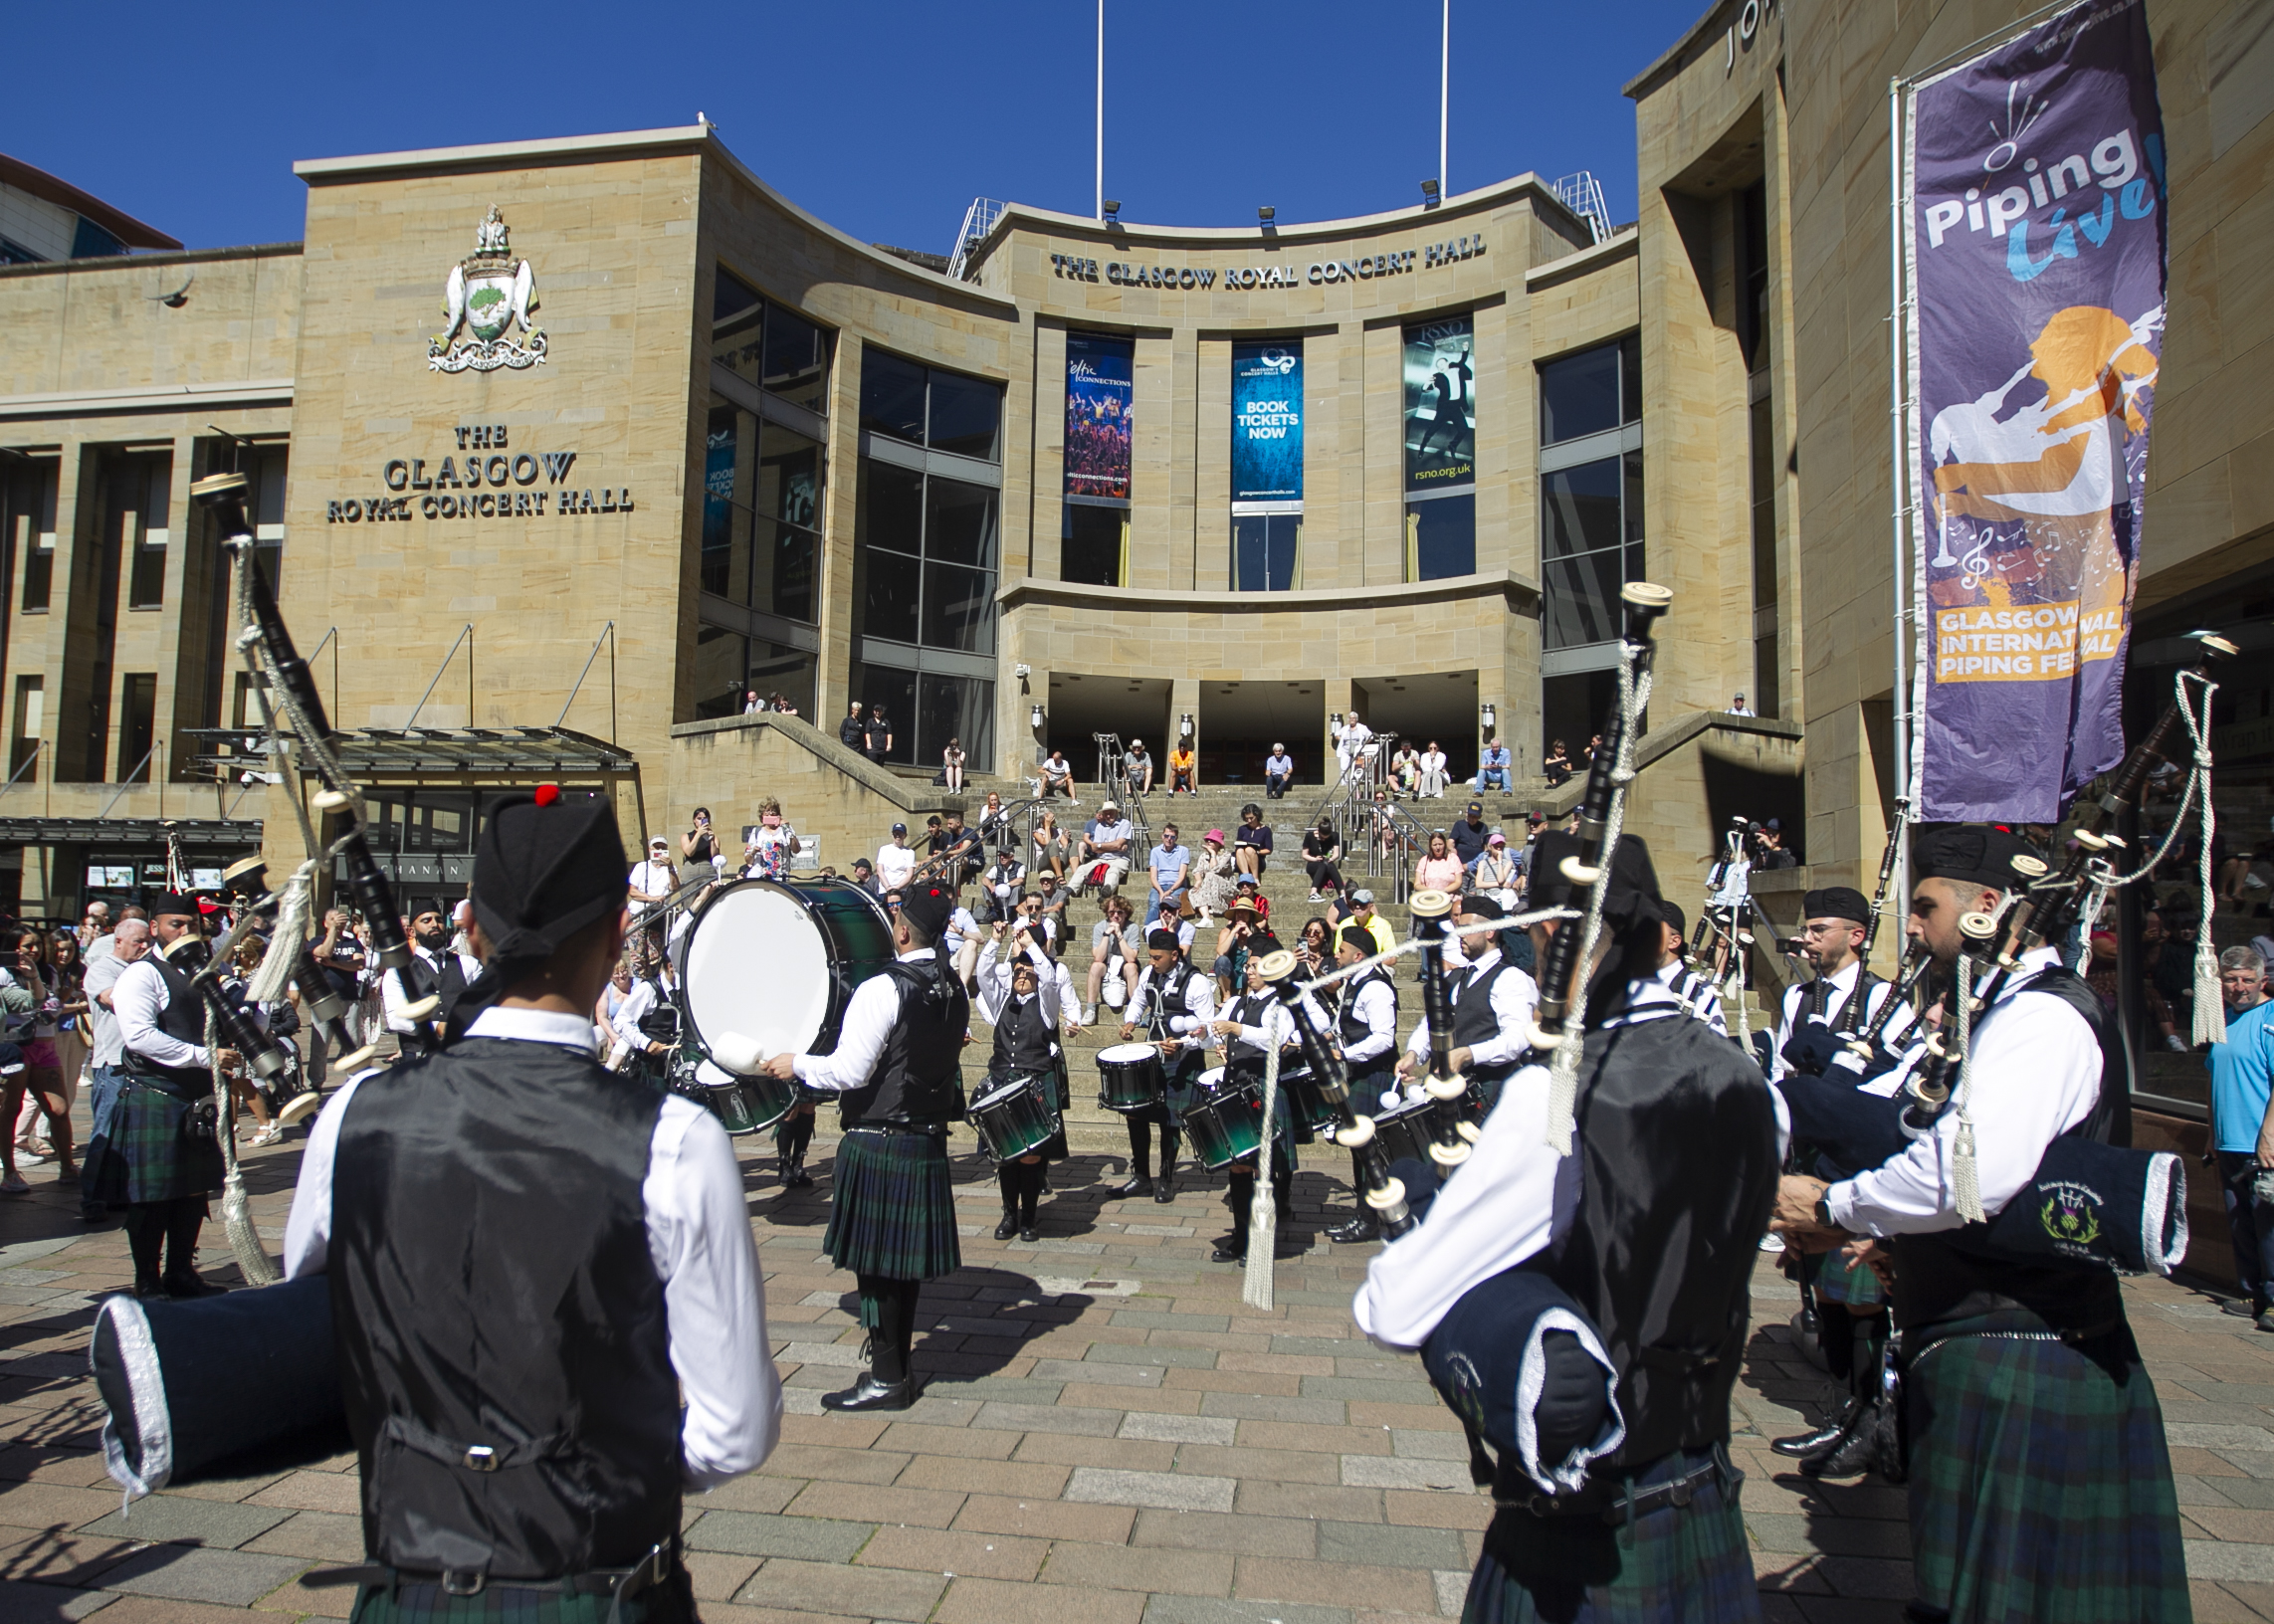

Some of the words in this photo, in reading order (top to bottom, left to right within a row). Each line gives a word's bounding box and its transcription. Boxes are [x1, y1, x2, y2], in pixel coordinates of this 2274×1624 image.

[1925, 127, 2138, 249] Piping
[1051, 253, 1099, 283] THE
[1106, 261, 1217, 291] GLASGOW
[1224, 266, 1299, 290] ROYAL
[1307, 249, 1417, 286] CONCERT
[1425, 233, 1488, 269] HALL
[1421, 319, 1464, 341] RSNO
[466, 354, 501, 369] GLASGOW
[1077, 375, 1132, 387] CONNECTIONS
[1246, 400, 1290, 414] BOOK
[1237, 413, 1299, 427] TICKETS
[454, 424, 508, 449] THE
[1248, 426, 1288, 440] NOW
[384, 451, 577, 490] GLASGOW
[1415, 463, 1472, 481] rsno.org.uk
[326, 497, 412, 522] ROYAL
[420, 491, 548, 518] CONCERT
[556, 487, 634, 515] HALL
[1941, 605, 2079, 632] GLASGOW
[1941, 656, 2033, 677] PIPING
[380, 864, 460, 876] CHANAN
